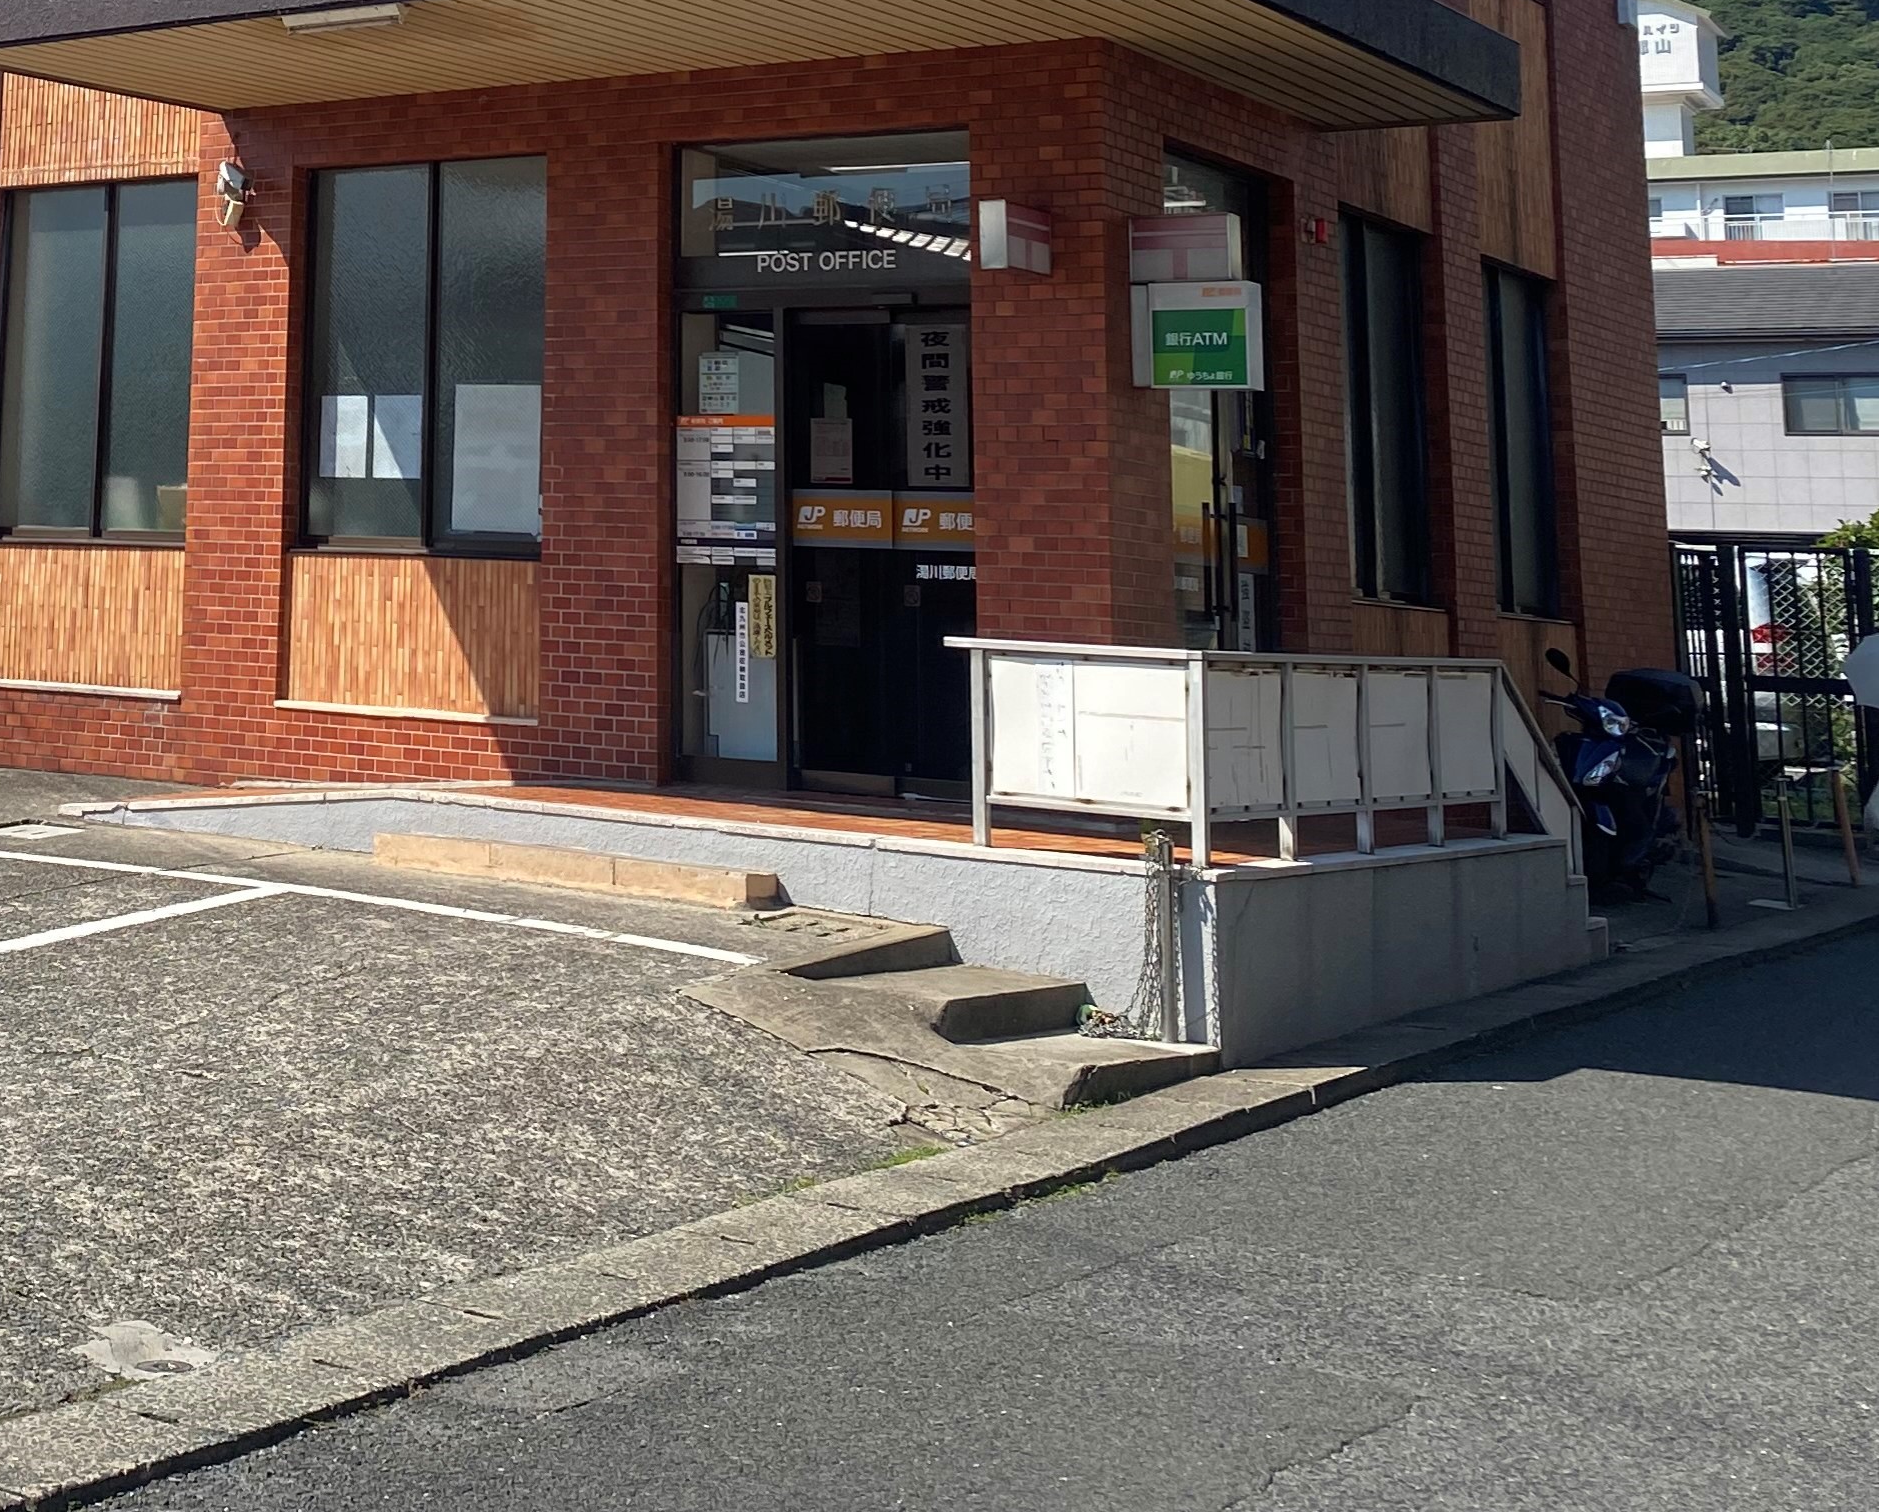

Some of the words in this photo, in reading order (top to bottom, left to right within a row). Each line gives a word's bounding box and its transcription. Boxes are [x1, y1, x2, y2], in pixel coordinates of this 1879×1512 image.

[709, 184, 953, 231] 湯川郵便局
[756, 252, 813, 273] POST
[818, 249, 897, 271] OFFICE
[1165, 331, 1228, 346] 銀行ATM
[920, 330, 952, 481] 夜間警戒強化中
[798, 505, 826, 523] JP
[832, 509, 882, 529] 郵便局
[901, 508, 932, 527] JP
